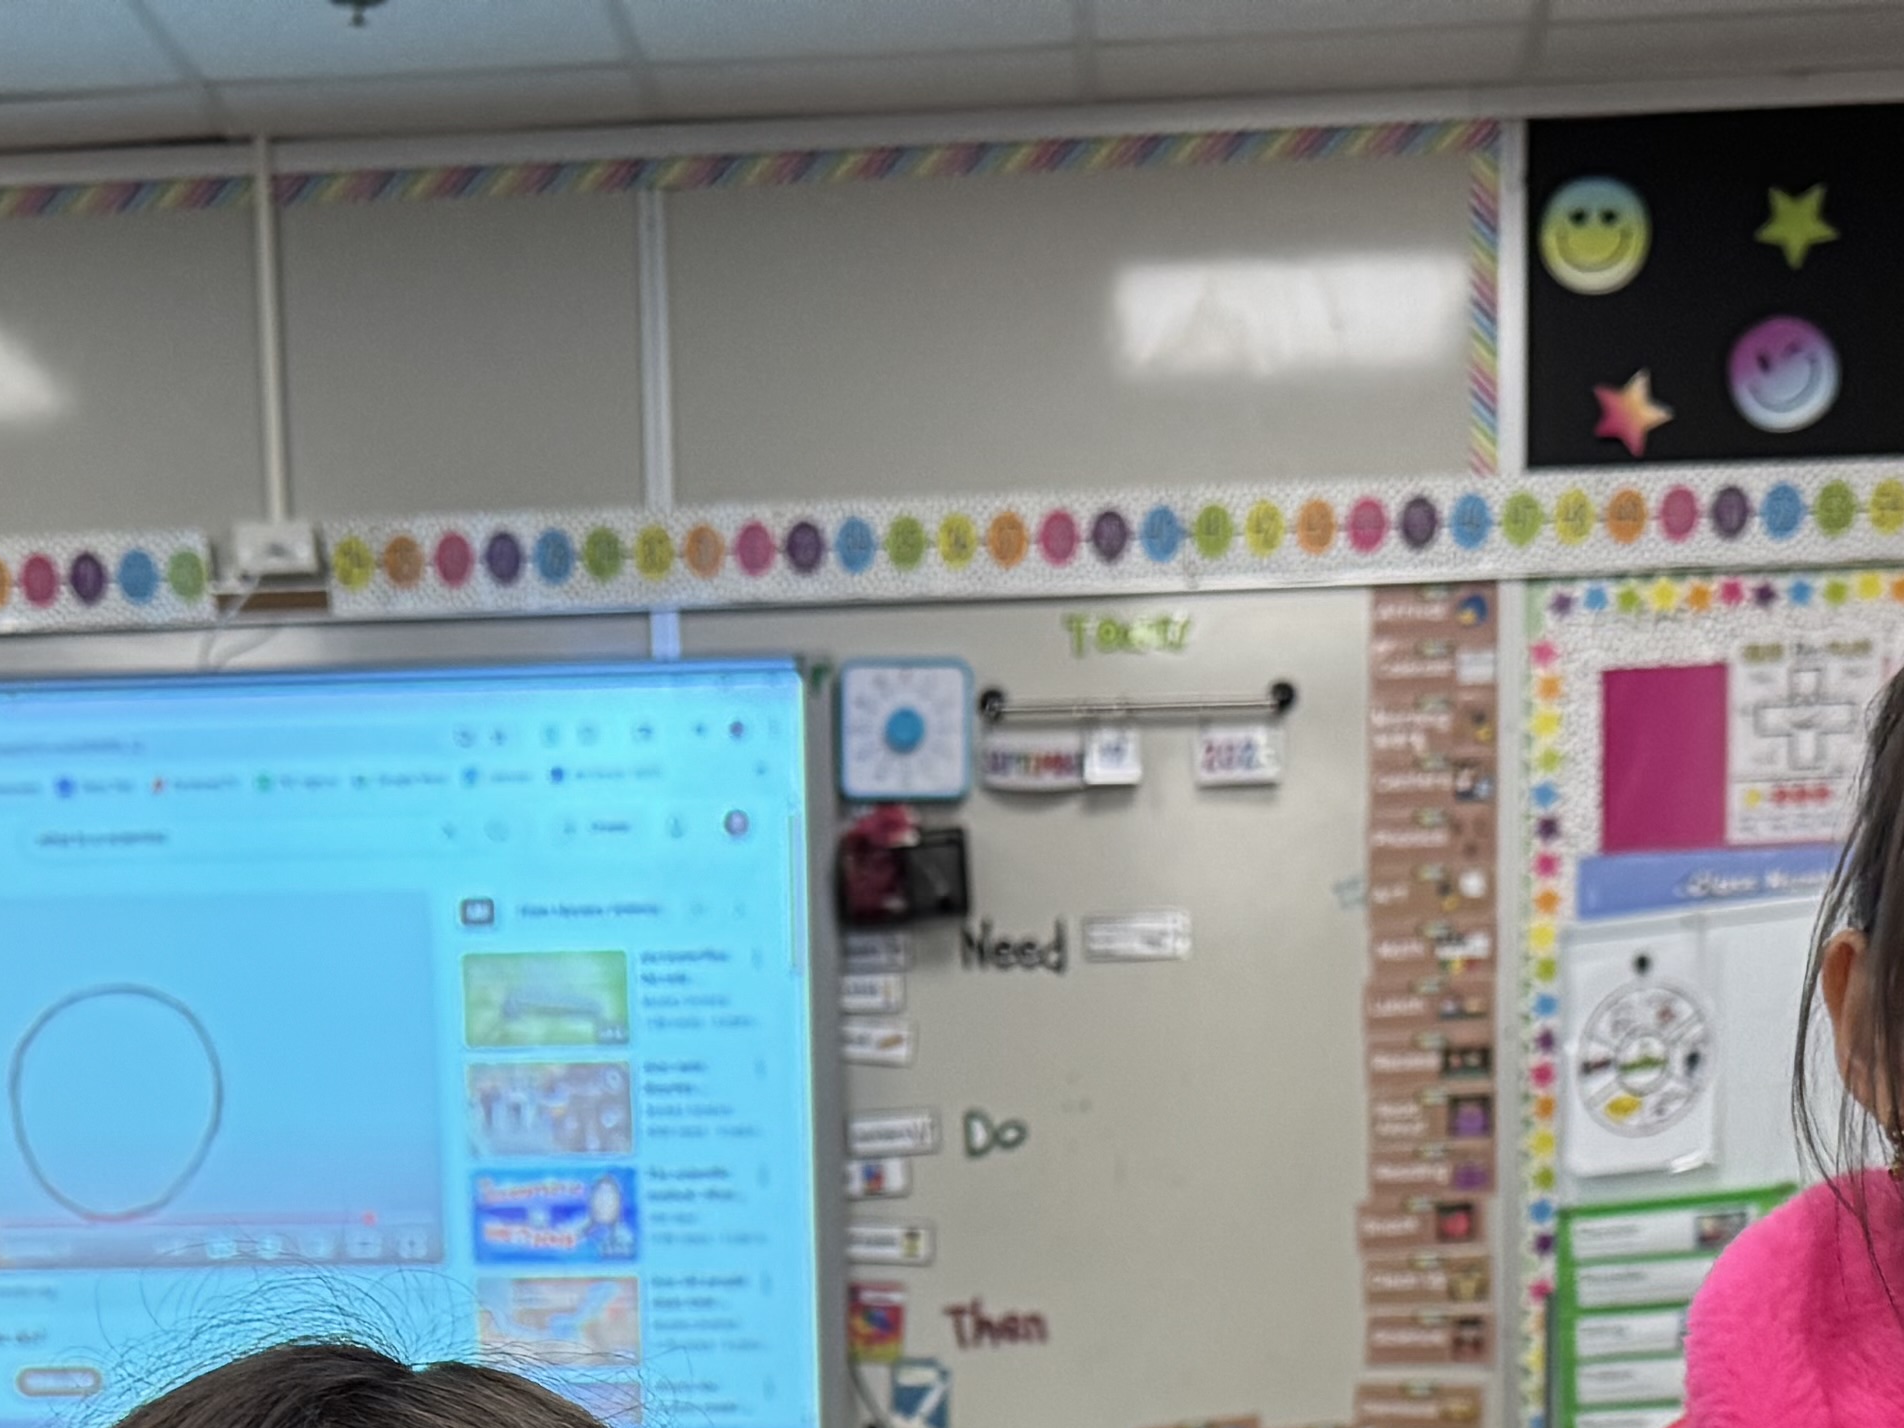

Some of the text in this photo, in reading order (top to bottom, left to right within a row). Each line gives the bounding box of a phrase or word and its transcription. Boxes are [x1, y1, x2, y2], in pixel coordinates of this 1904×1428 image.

[959, 917, 1067, 976] Need
[963, 1108, 1028, 1158] Do
[942, 1297, 1051, 1350] Then
